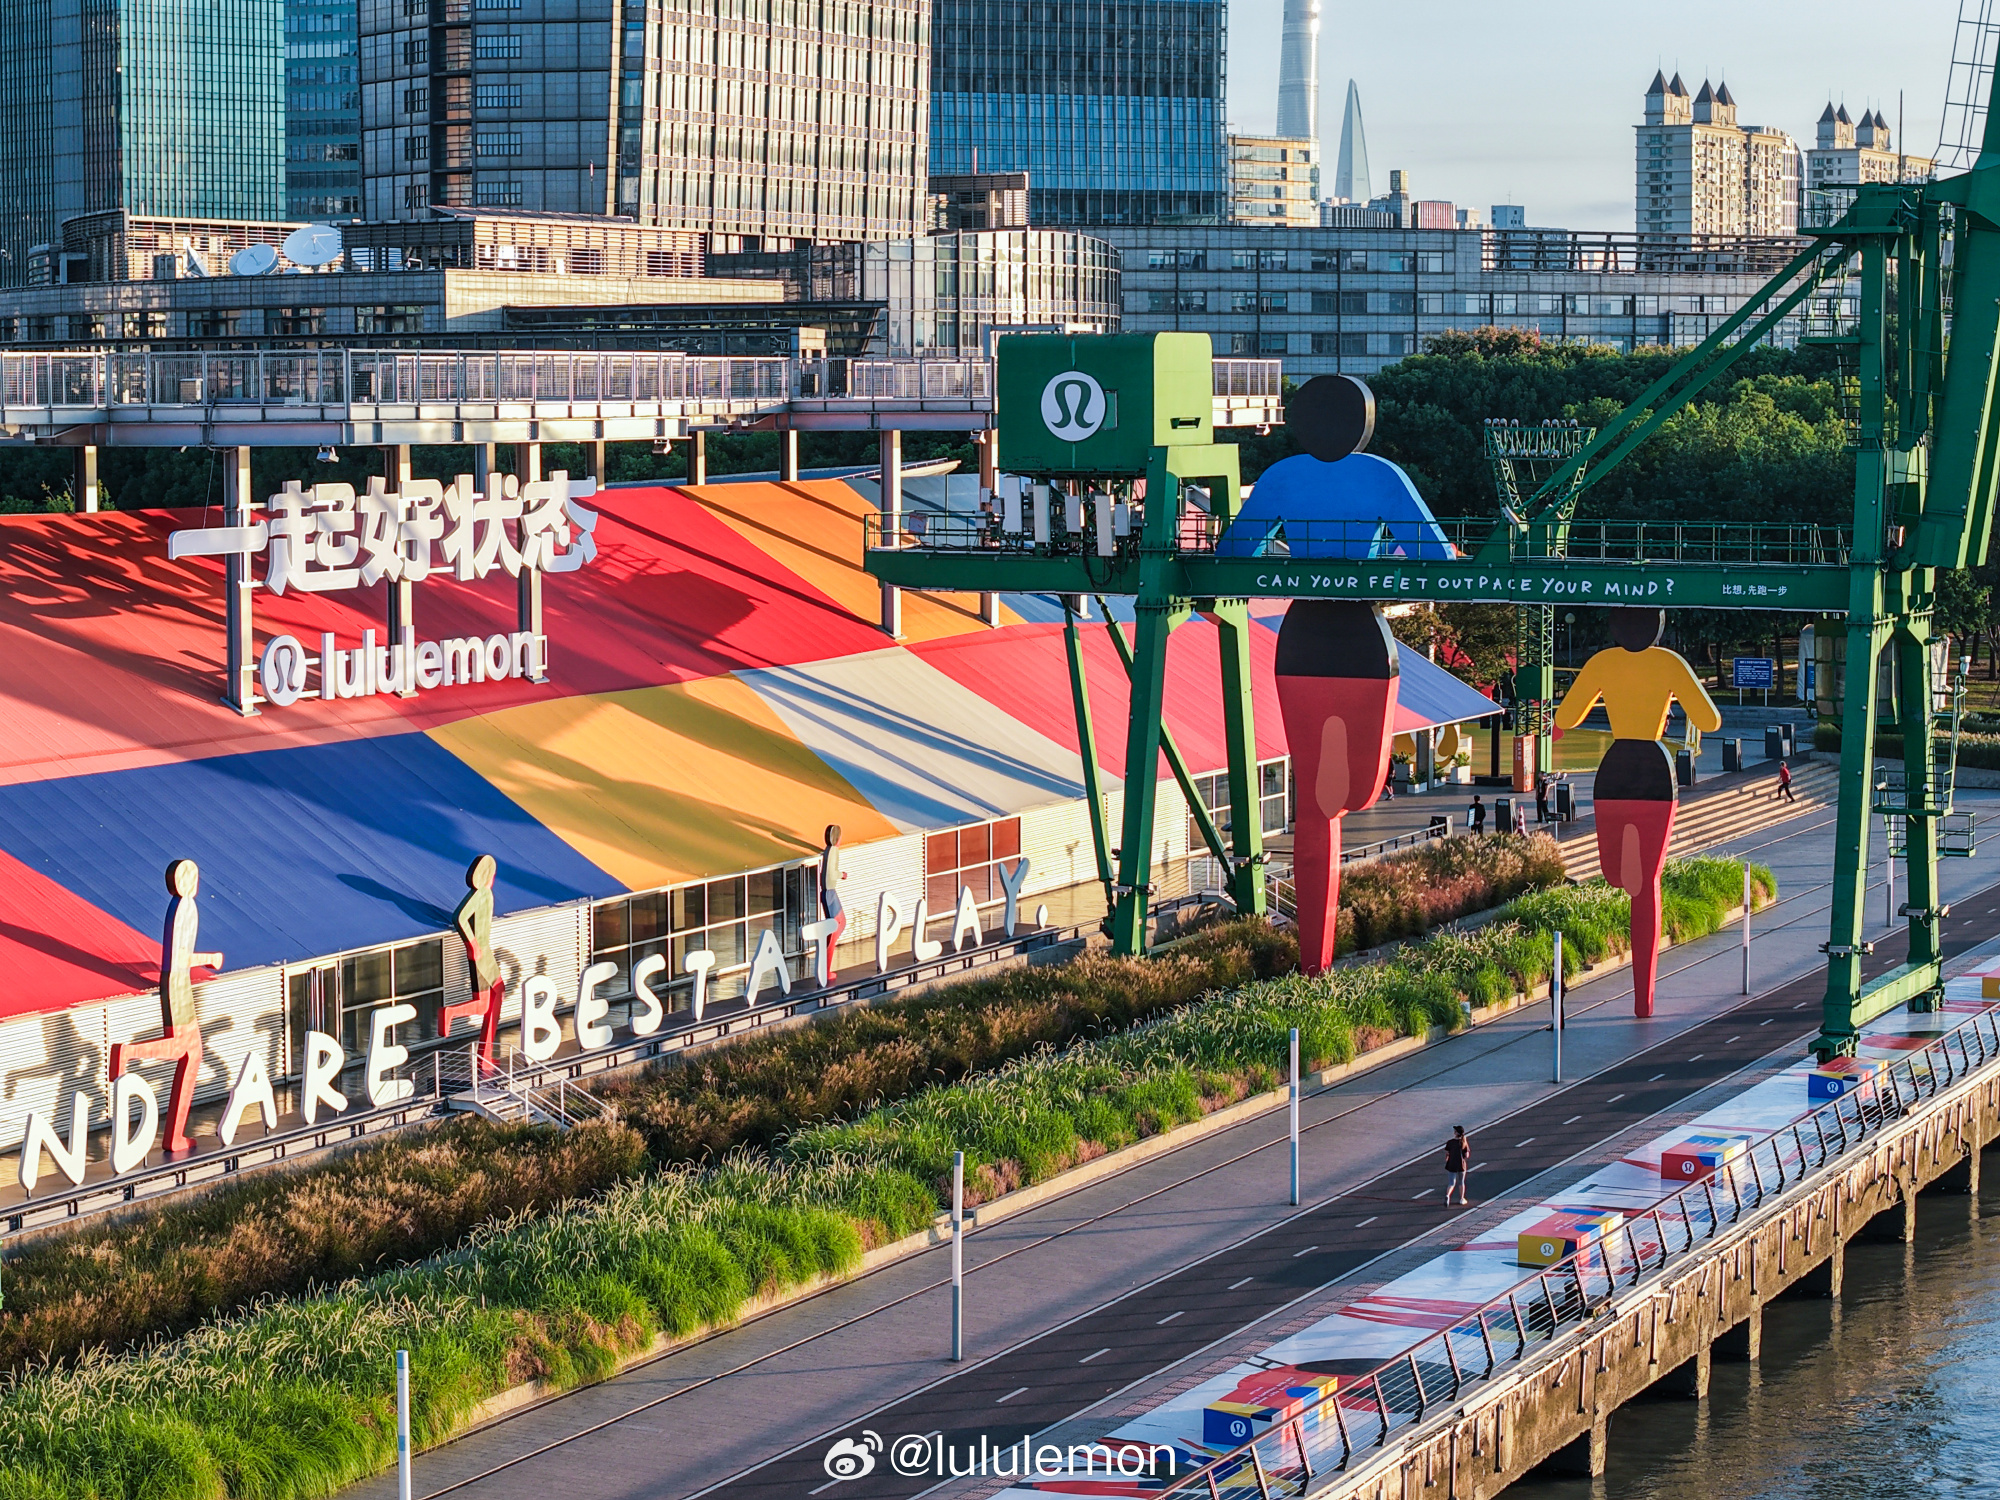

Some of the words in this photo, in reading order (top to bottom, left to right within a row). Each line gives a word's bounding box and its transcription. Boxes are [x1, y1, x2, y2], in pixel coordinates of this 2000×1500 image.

[168, 470, 599, 596] 一起好状态
[1256, 574, 1300, 587] CAN
[1310, 574, 1358, 588] YOUR
[1369, 576, 1428, 590] FEET
[1438, 575, 1532, 591] OUTPACE
[1541, 577, 1592, 594] YOUR
[1604, 578, 1674, 596] MIND?
[321, 625, 539, 700] lululemon
[217, 1004, 417, 1146] ARE
[521, 948, 716, 1065] BEST
[744, 918, 838, 1007] AT
